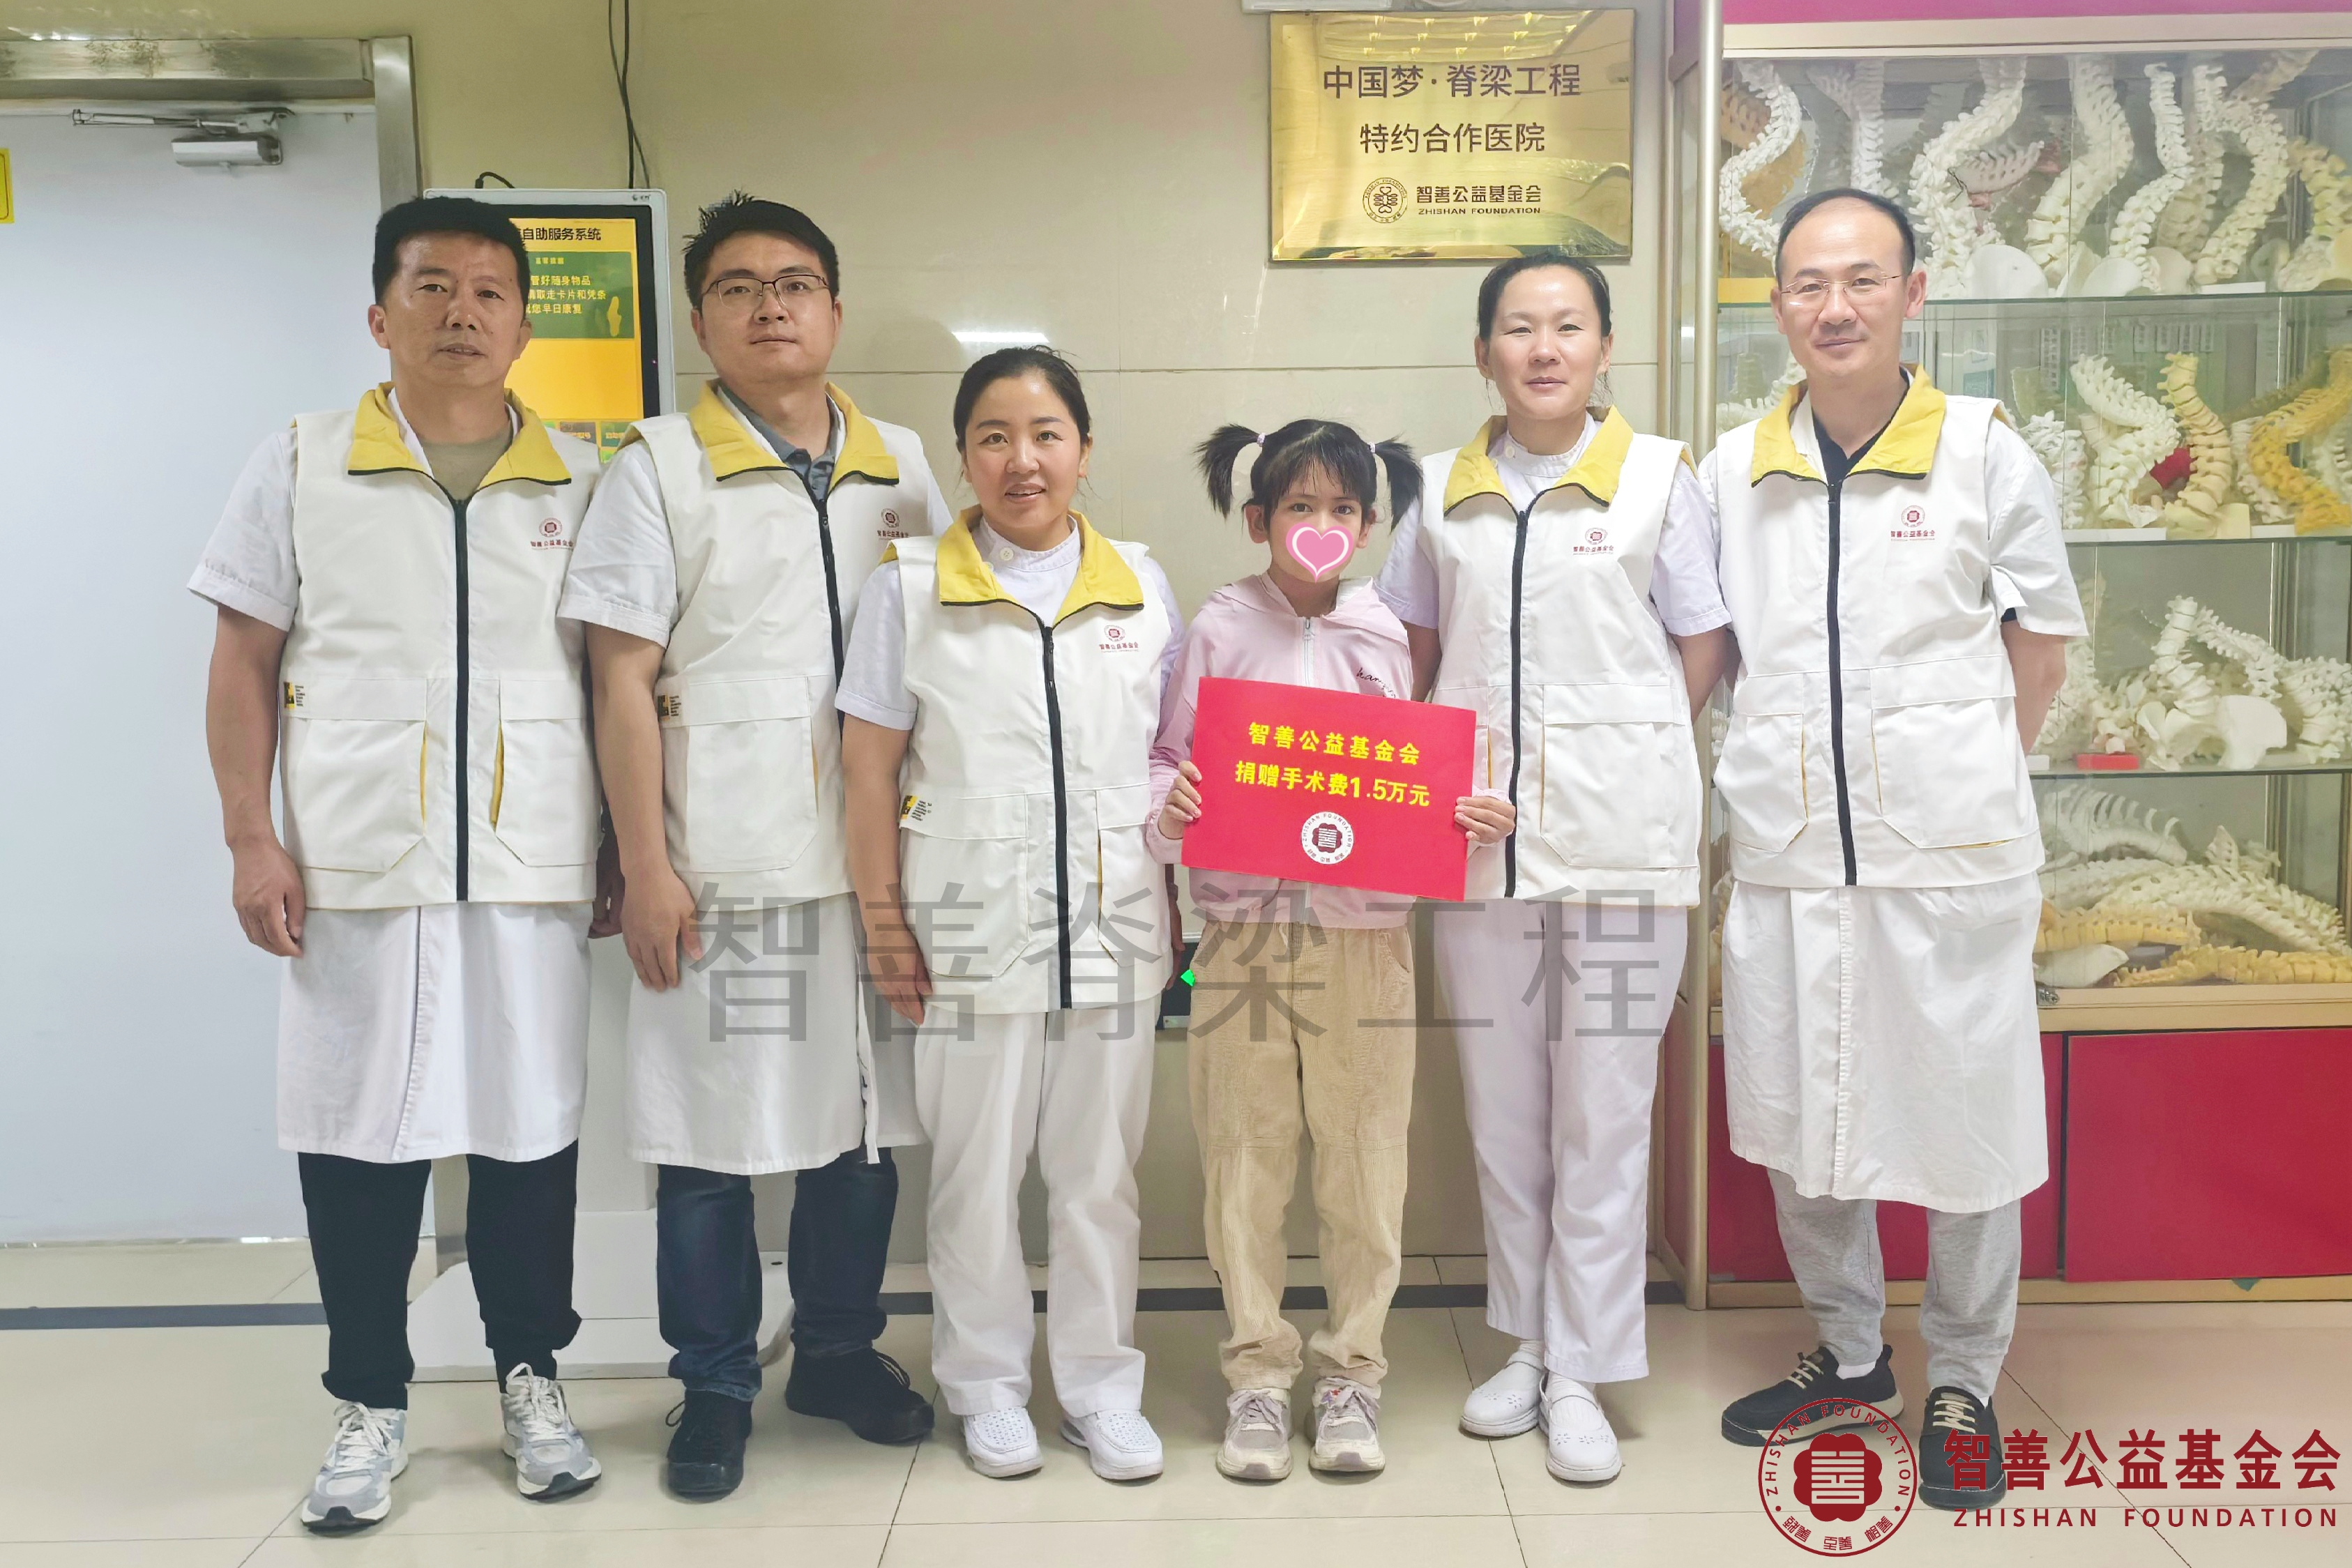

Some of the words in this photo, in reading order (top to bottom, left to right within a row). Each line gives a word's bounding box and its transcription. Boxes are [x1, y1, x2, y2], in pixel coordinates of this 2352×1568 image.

[1323, 63, 1581, 99] 中国梦·脊梁工程
[1360, 122, 1545, 153] 特约合作医院
[1416, 185, 1541, 204] 智善公益基金会
[1248, 722, 1420, 766] 智善公益基金会
[1235, 760, 1430, 807] 捐赠手术费1.5万元
